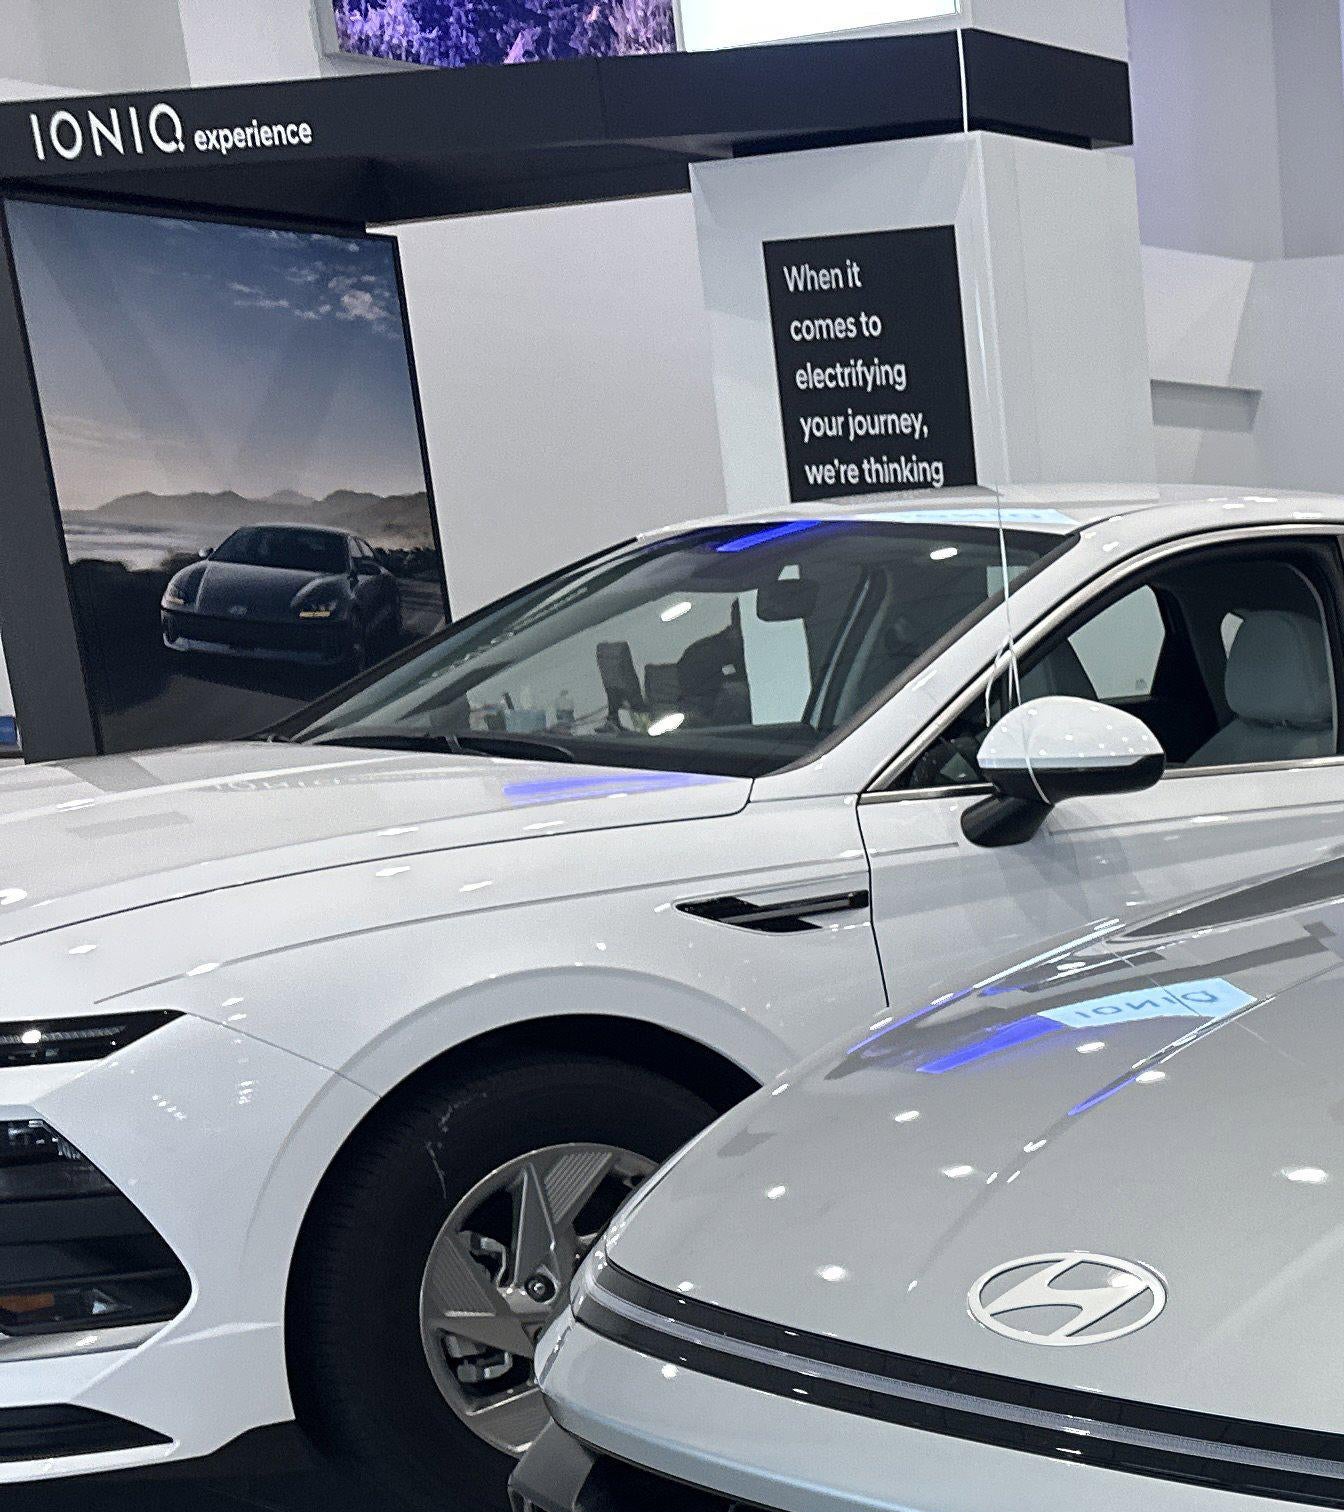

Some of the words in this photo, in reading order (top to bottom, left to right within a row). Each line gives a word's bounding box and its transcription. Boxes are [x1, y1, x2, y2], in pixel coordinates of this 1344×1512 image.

[30, 103, 184, 159] IONIQ
[195, 119, 312, 154] experience
[784, 264, 844, 292] When
[846, 260, 862, 287] it
[790, 317, 857, 341] comes
[859, 312, 882, 337] to
[796, 358, 906, 392] electrifying
[800, 415, 844, 443] your
[847, 408, 928, 441] journey,
[805, 459, 859, 484] we're
[862, 455, 944, 487] thinking
